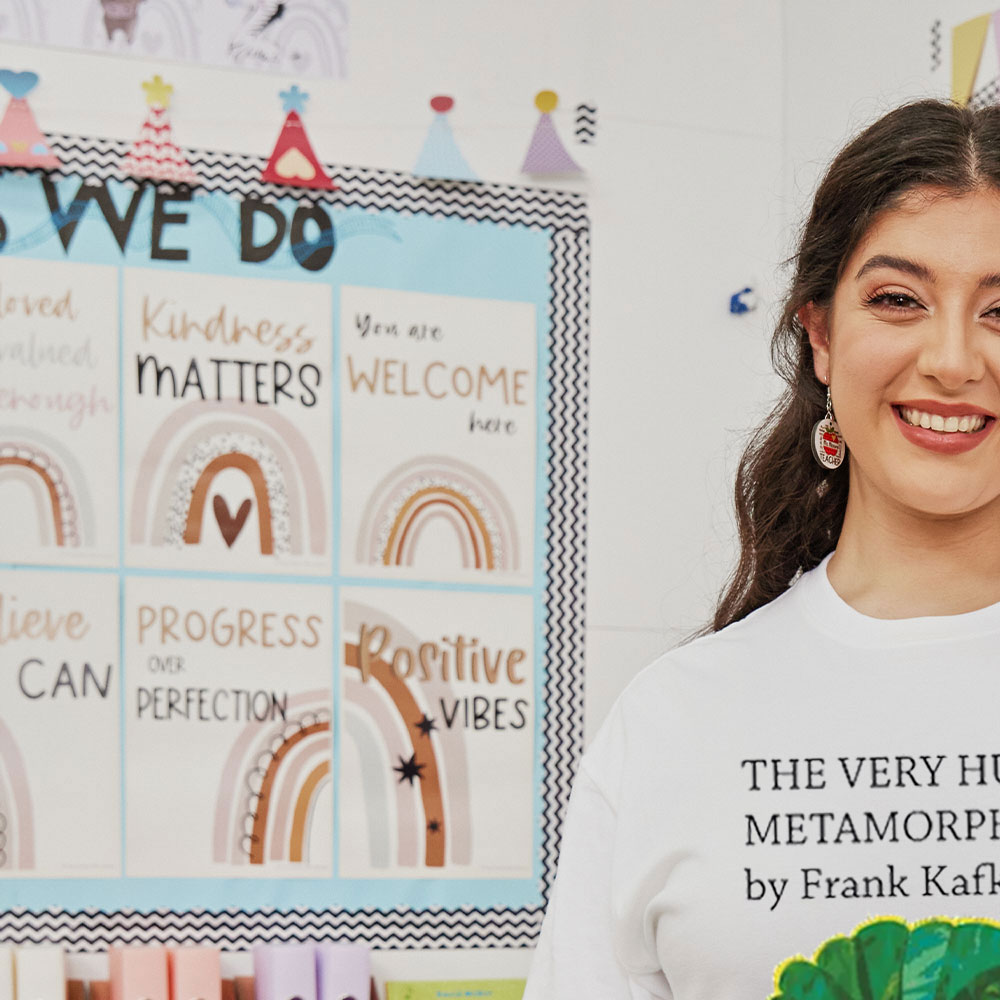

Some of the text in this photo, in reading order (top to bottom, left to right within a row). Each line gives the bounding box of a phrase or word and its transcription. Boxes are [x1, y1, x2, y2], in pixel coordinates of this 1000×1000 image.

[40, 174, 194, 261] WE
[239, 195, 336, 272] DO
[141, 295, 318, 353] Kindness
[355, 312, 444, 342] You are
[346, 354, 530, 406] WELCOME
[468, 409, 518, 435] here
[136, 604, 324, 649] PROGRESS
[148, 654, 184, 675] OVER
[358, 622, 528, 685] Positive
[17, 658, 113, 700] CAN
[136, 687, 289, 723] PERFECTION
[438, 695, 530, 731] VIBES
[741, 758, 827, 791] THE
[838, 755, 947, 788] VERY
[744, 868, 789, 911] by
[801, 865, 910, 899] Frank
